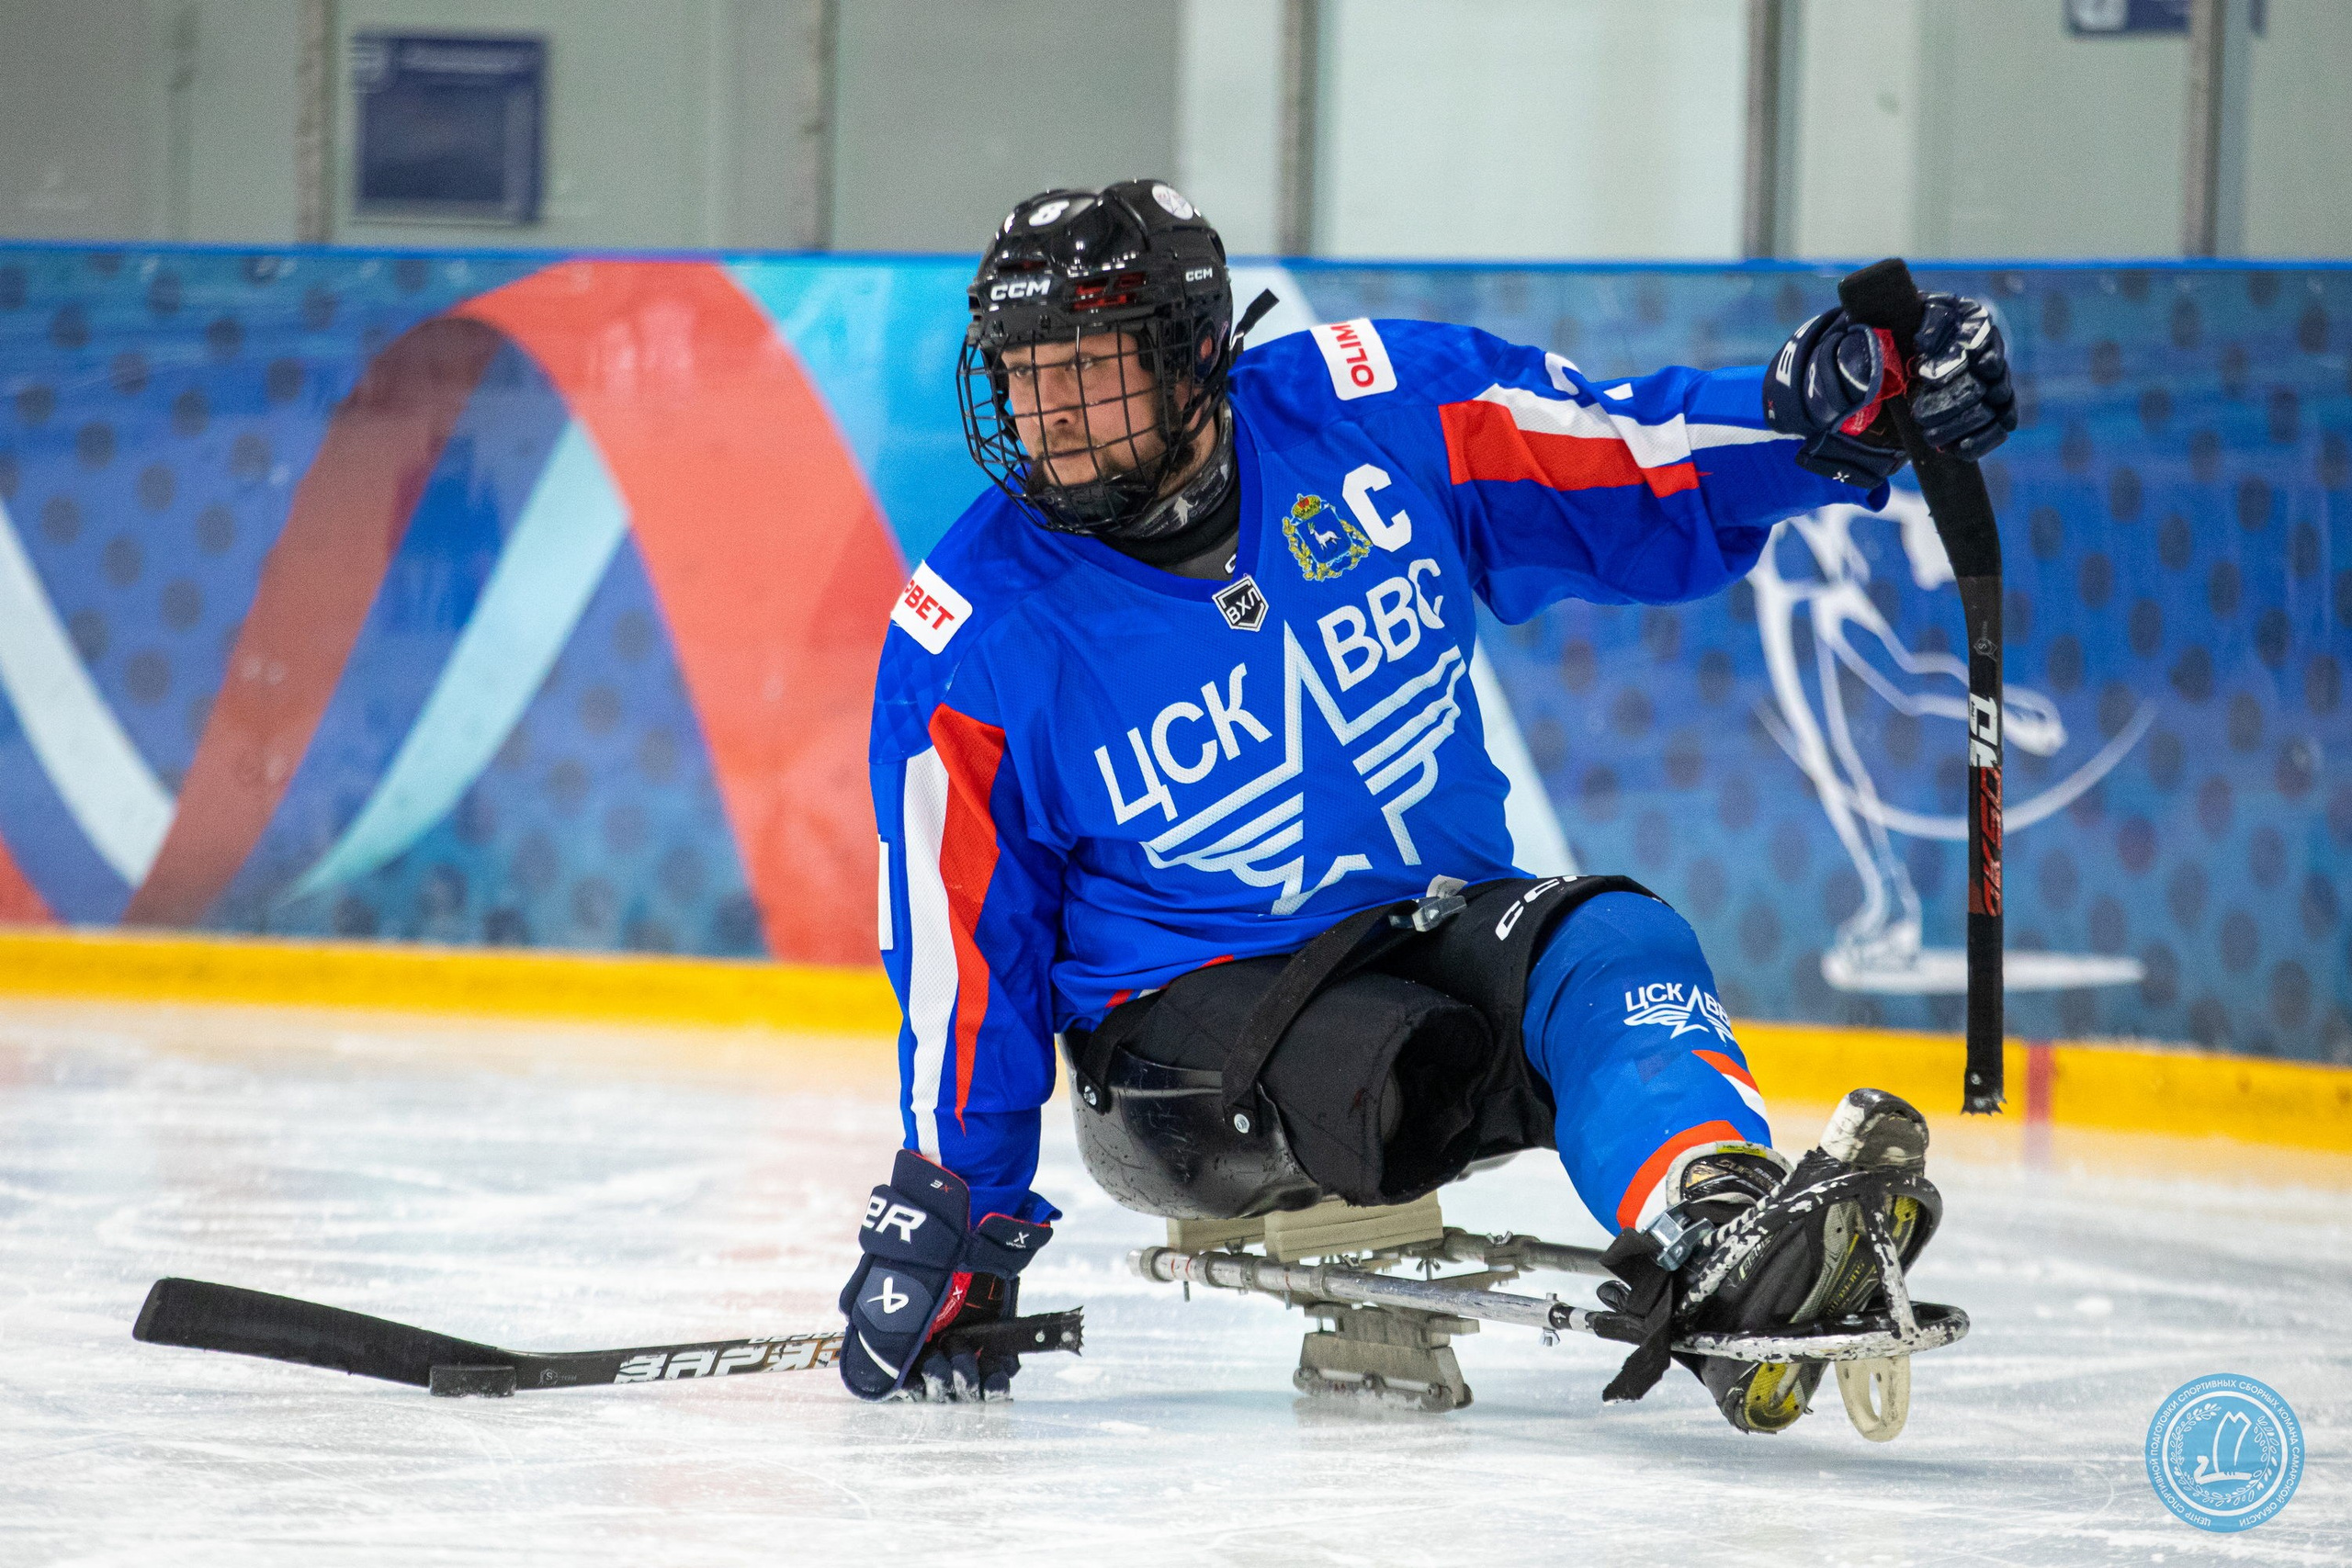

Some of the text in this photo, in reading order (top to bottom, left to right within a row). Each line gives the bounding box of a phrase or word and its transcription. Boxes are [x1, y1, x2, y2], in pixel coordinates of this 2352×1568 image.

[990, 280, 1051, 301] CCM
[1186, 268, 1213, 282] CCM
[1329, 321, 1374, 388] OLIM
[1226, 587, 1261, 625] ВХЛ
[1093, 558, 1442, 825] ЦСК ВВС
[1495, 875, 1577, 941] CC
[1625, 982, 1685, 1012] ЦСК
